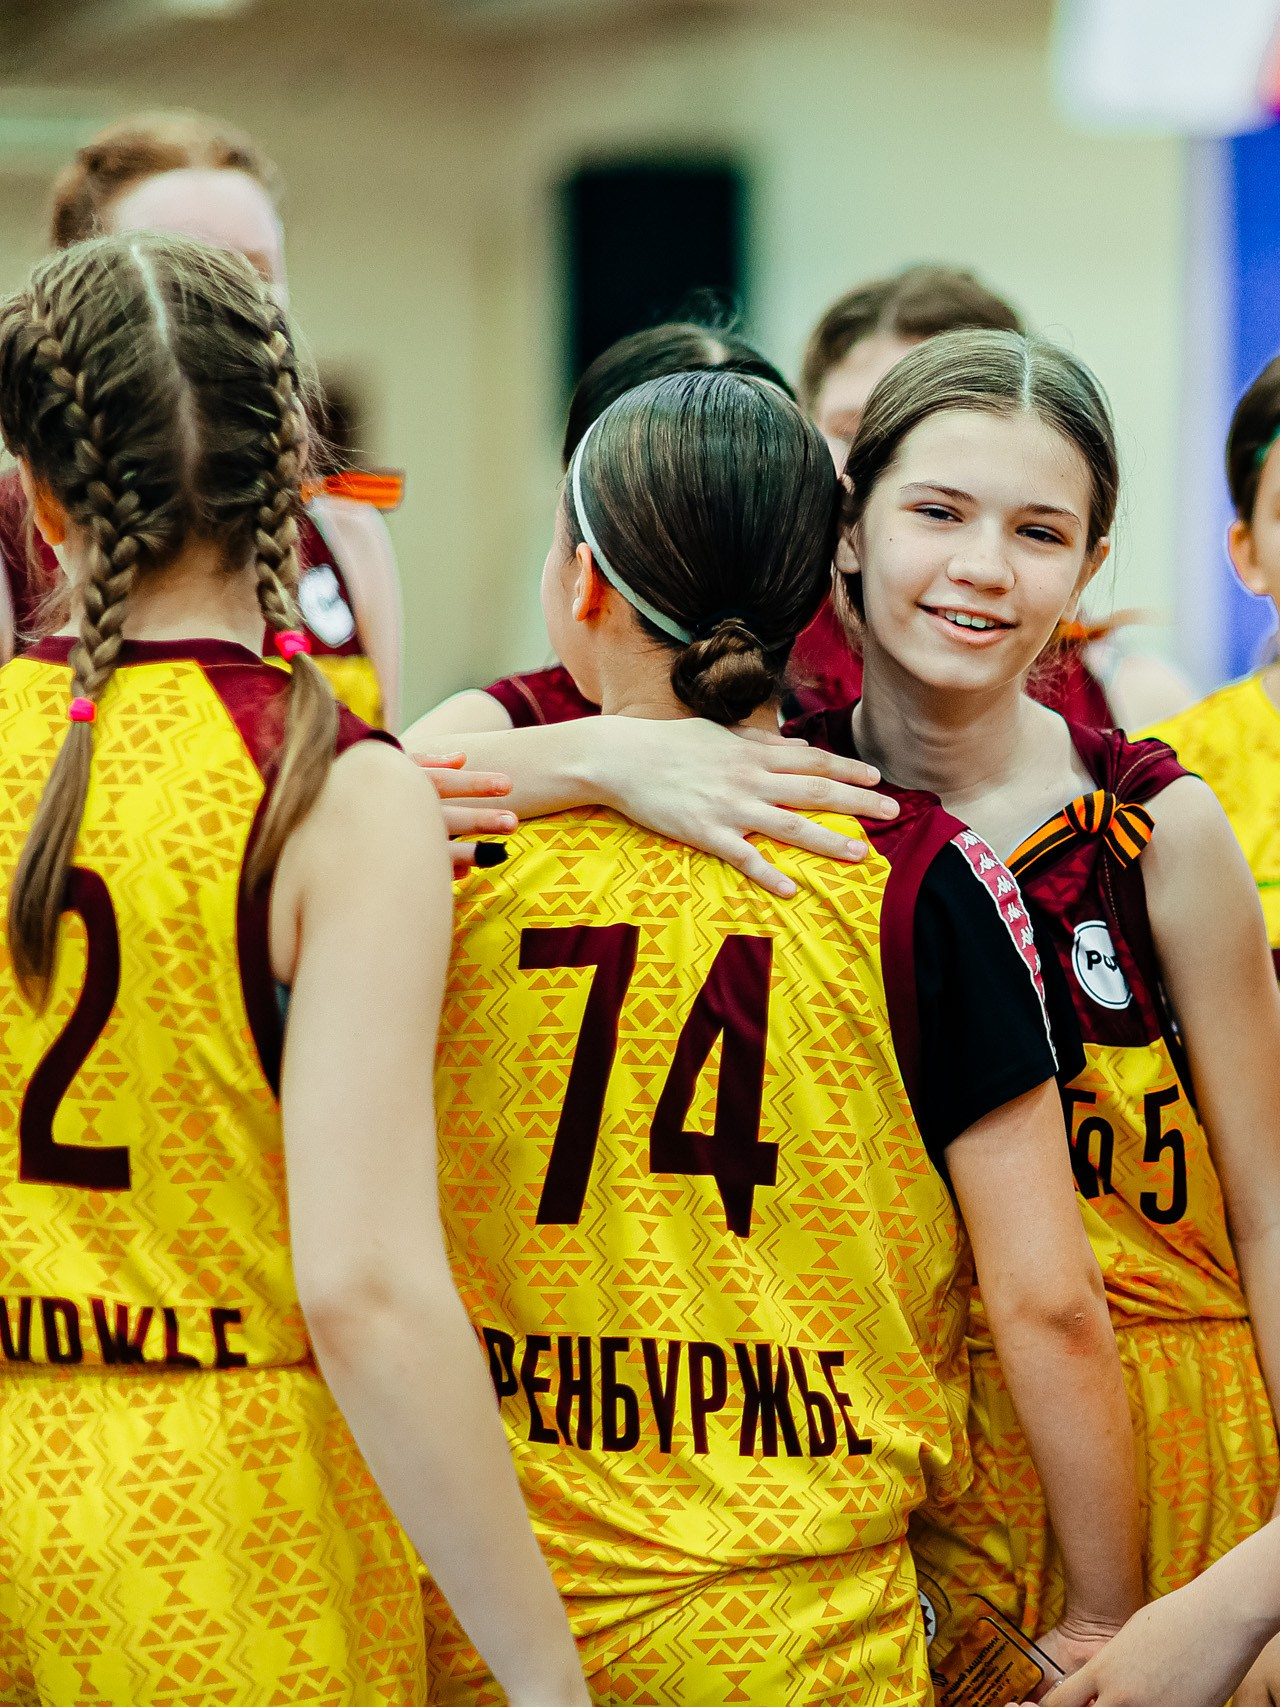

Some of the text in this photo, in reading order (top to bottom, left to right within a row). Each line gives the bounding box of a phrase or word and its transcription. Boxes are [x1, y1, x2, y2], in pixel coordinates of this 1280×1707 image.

[16, 866, 132, 1190] 2
[517, 922, 780, 1239] 74
[482, 1326, 873, 1458] РЕНБУРЖЬЕ
